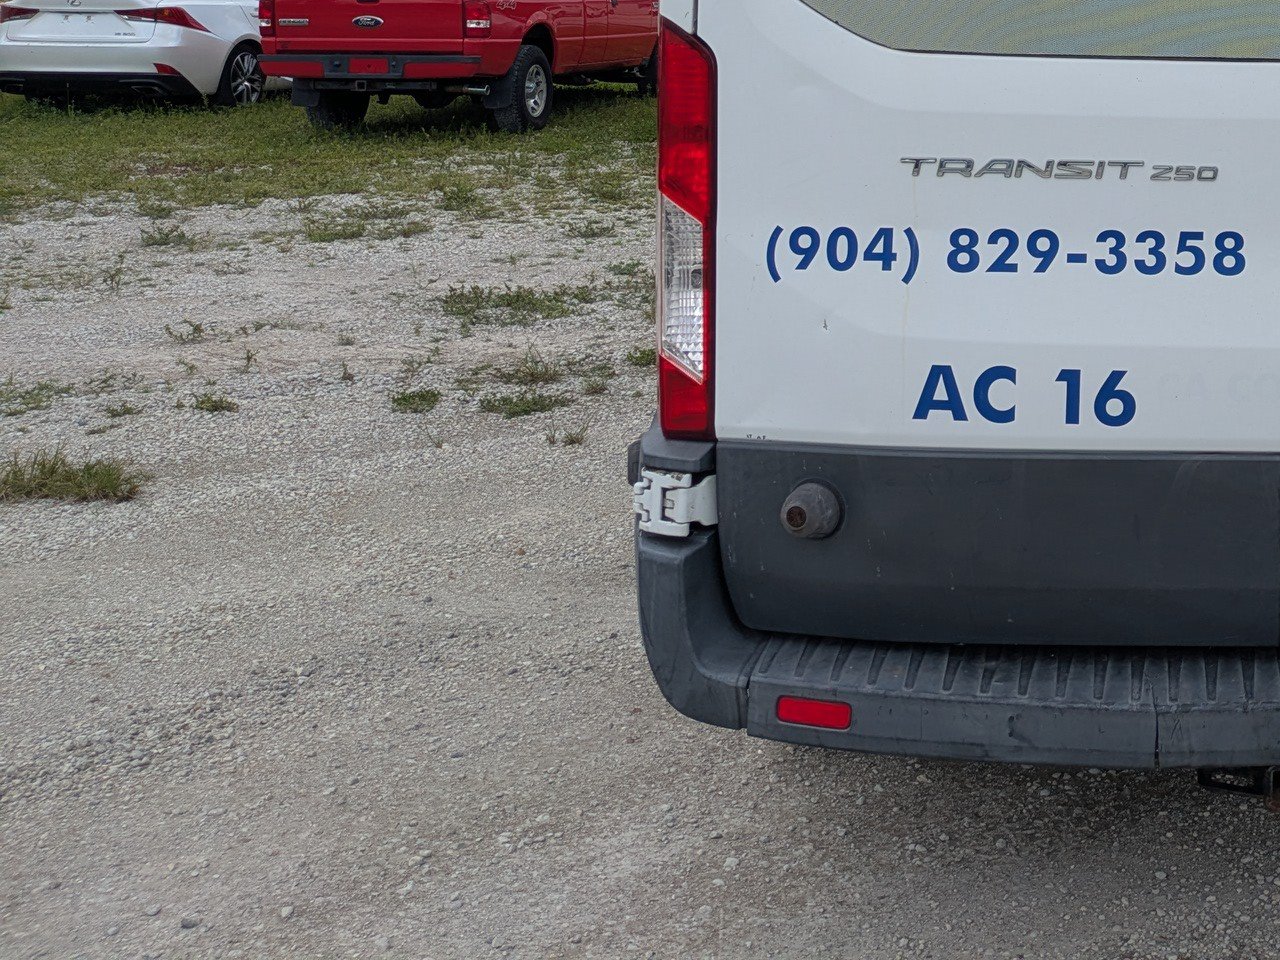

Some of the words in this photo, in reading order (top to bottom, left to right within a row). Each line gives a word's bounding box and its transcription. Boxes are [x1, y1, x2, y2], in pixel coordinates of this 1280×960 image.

[900, 157, 1145, 180] TRANSIT
[1150, 165, 1219, 181] 250
[767, 225, 919, 285] (904)
[946, 228, 1246, 276] 829-3358
[912, 364, 1016, 424] AC
[1055, 369, 1136, 427] 16
